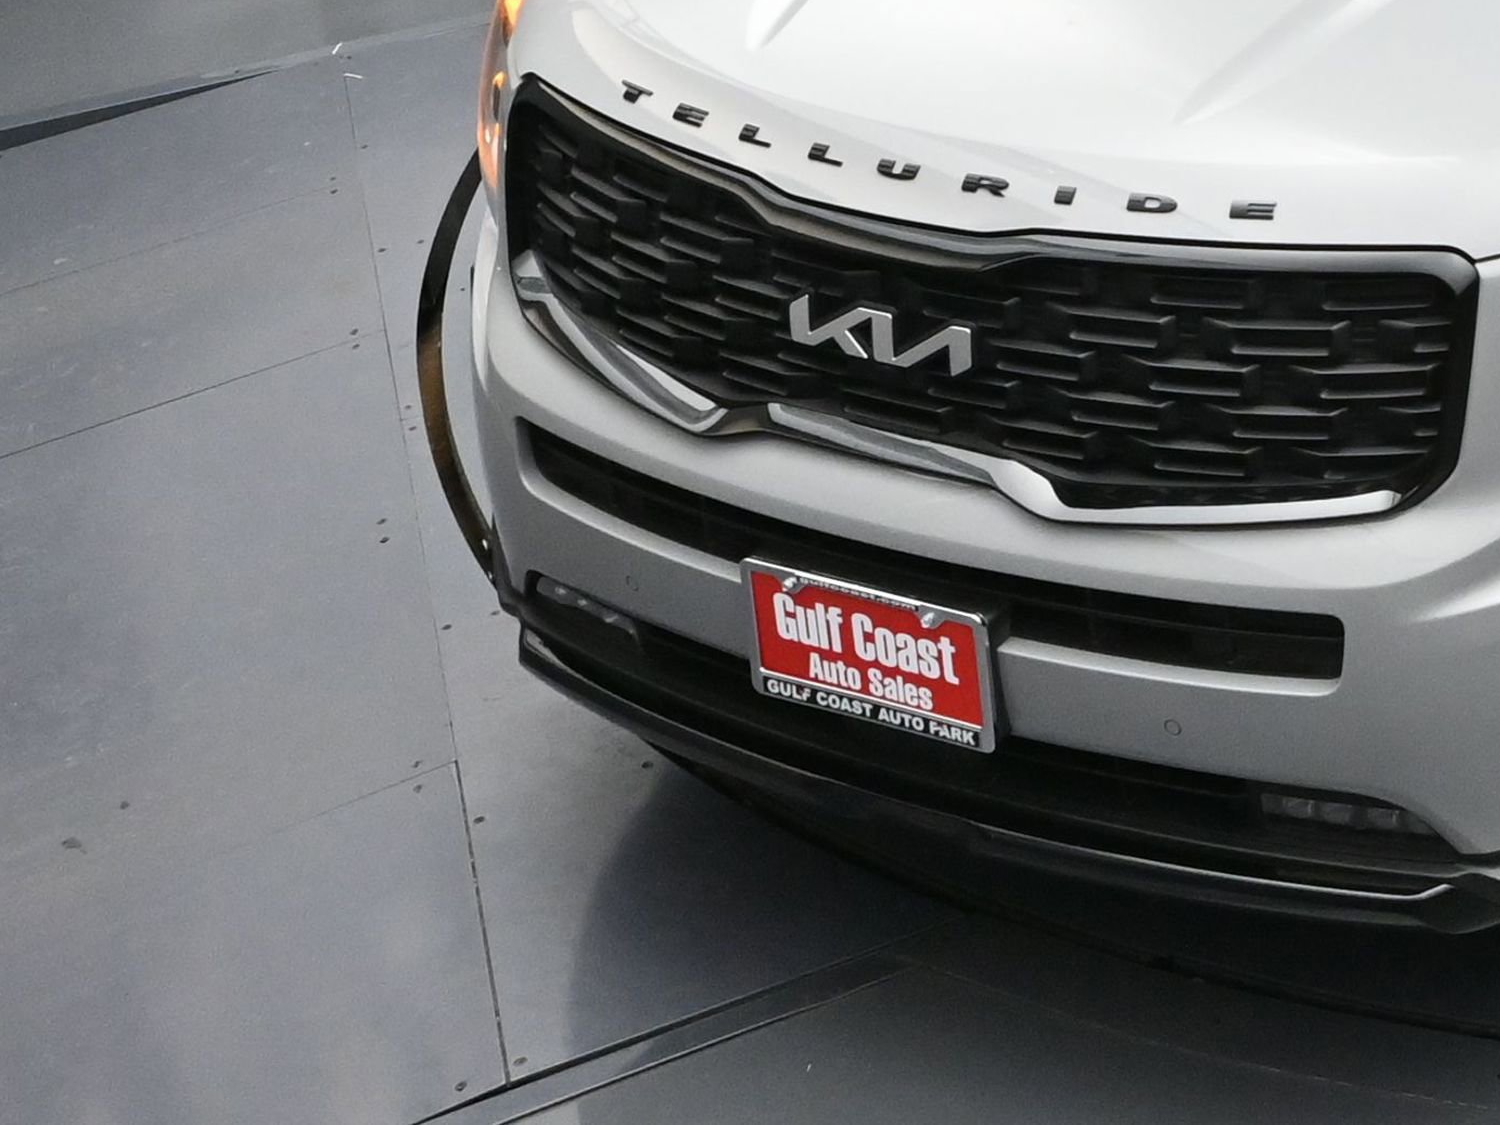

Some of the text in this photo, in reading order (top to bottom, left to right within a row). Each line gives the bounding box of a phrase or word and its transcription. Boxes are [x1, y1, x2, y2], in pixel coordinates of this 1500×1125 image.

[620, 79, 1279, 222] TELLURIDE
[772, 592, 960, 685] Gulf Coast
[766, 678, 976, 746] GULF COAST AUTO PARK
[809, 652, 934, 711] Auto Sales
